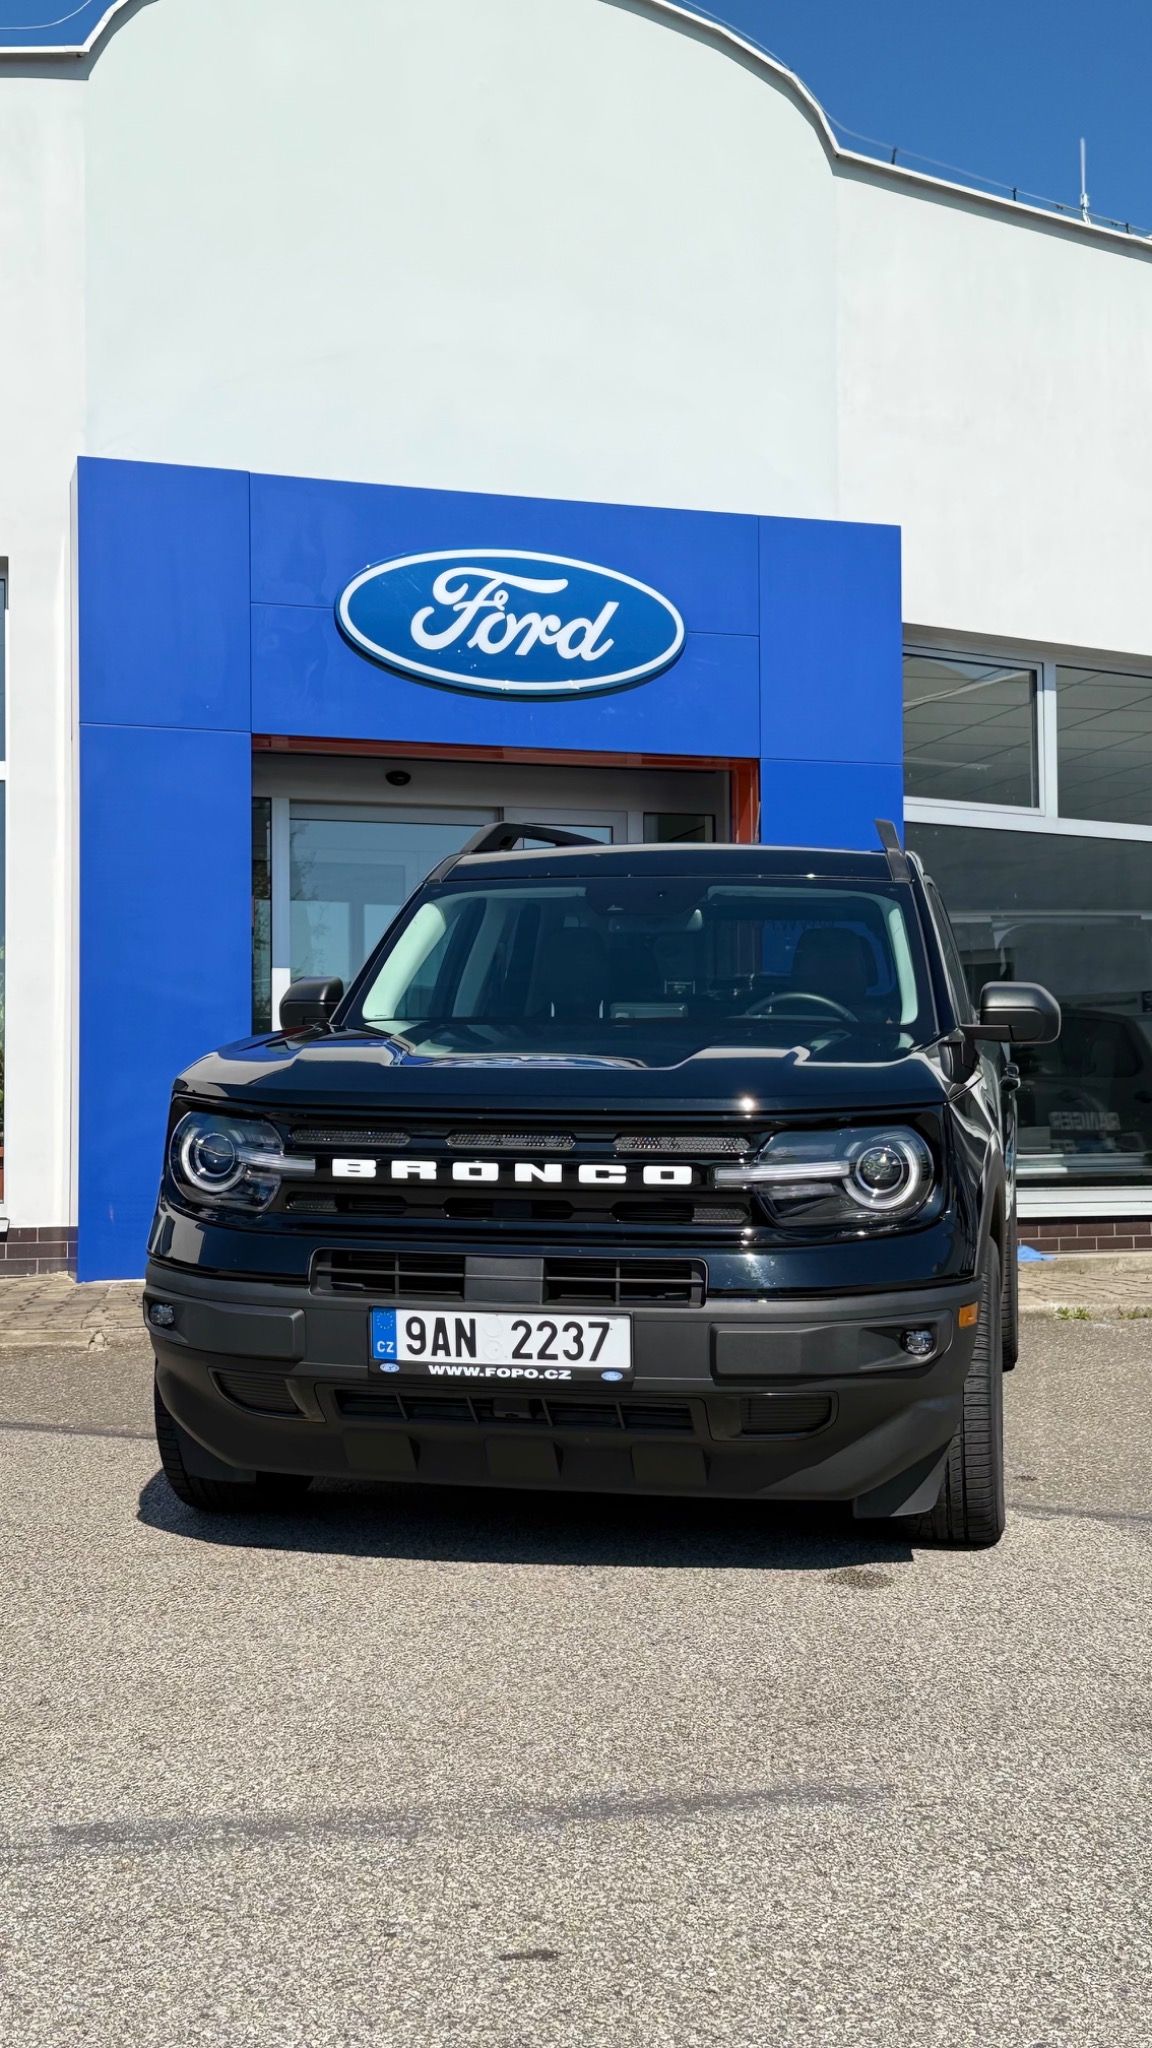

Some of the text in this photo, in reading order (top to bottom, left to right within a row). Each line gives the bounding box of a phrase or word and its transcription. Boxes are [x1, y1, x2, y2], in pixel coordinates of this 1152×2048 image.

[410, 567, 619, 661] Ford
[331, 1158, 692, 1184] BRONCO
[377, 1341, 394, 1353] CZ
[405, 1316, 610, 1362] 9AN 2237
[428, 1364, 572, 1380] WWW.FOPO.CZ
